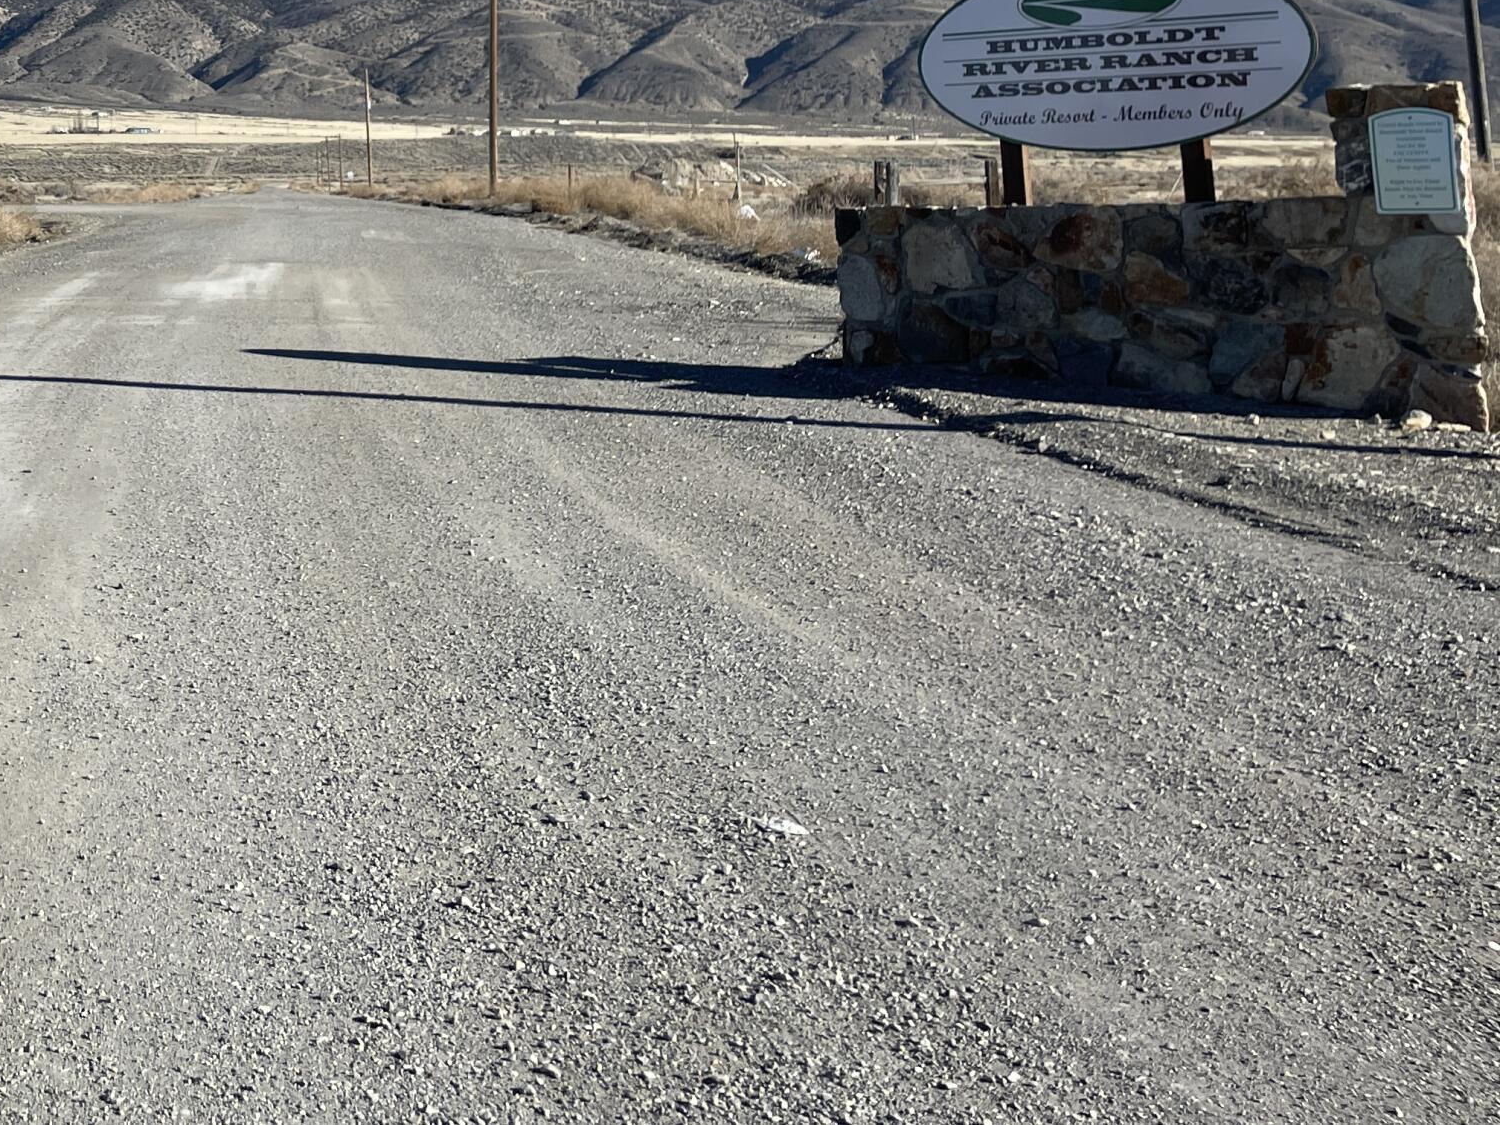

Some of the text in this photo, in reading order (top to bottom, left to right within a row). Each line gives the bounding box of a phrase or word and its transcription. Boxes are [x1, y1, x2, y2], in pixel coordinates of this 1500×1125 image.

[985, 25, 1226, 54] HUMBOLDT
[962, 46, 1259, 77] RIVER RANCH
[970, 71, 1251, 99] ASSOCIATION
[979, 110, 1037, 126] Private
[1041, 108, 1097, 124] Resort
[1113, 103, 1193, 122] Members
[1200, 100, 1245, 123] Only
